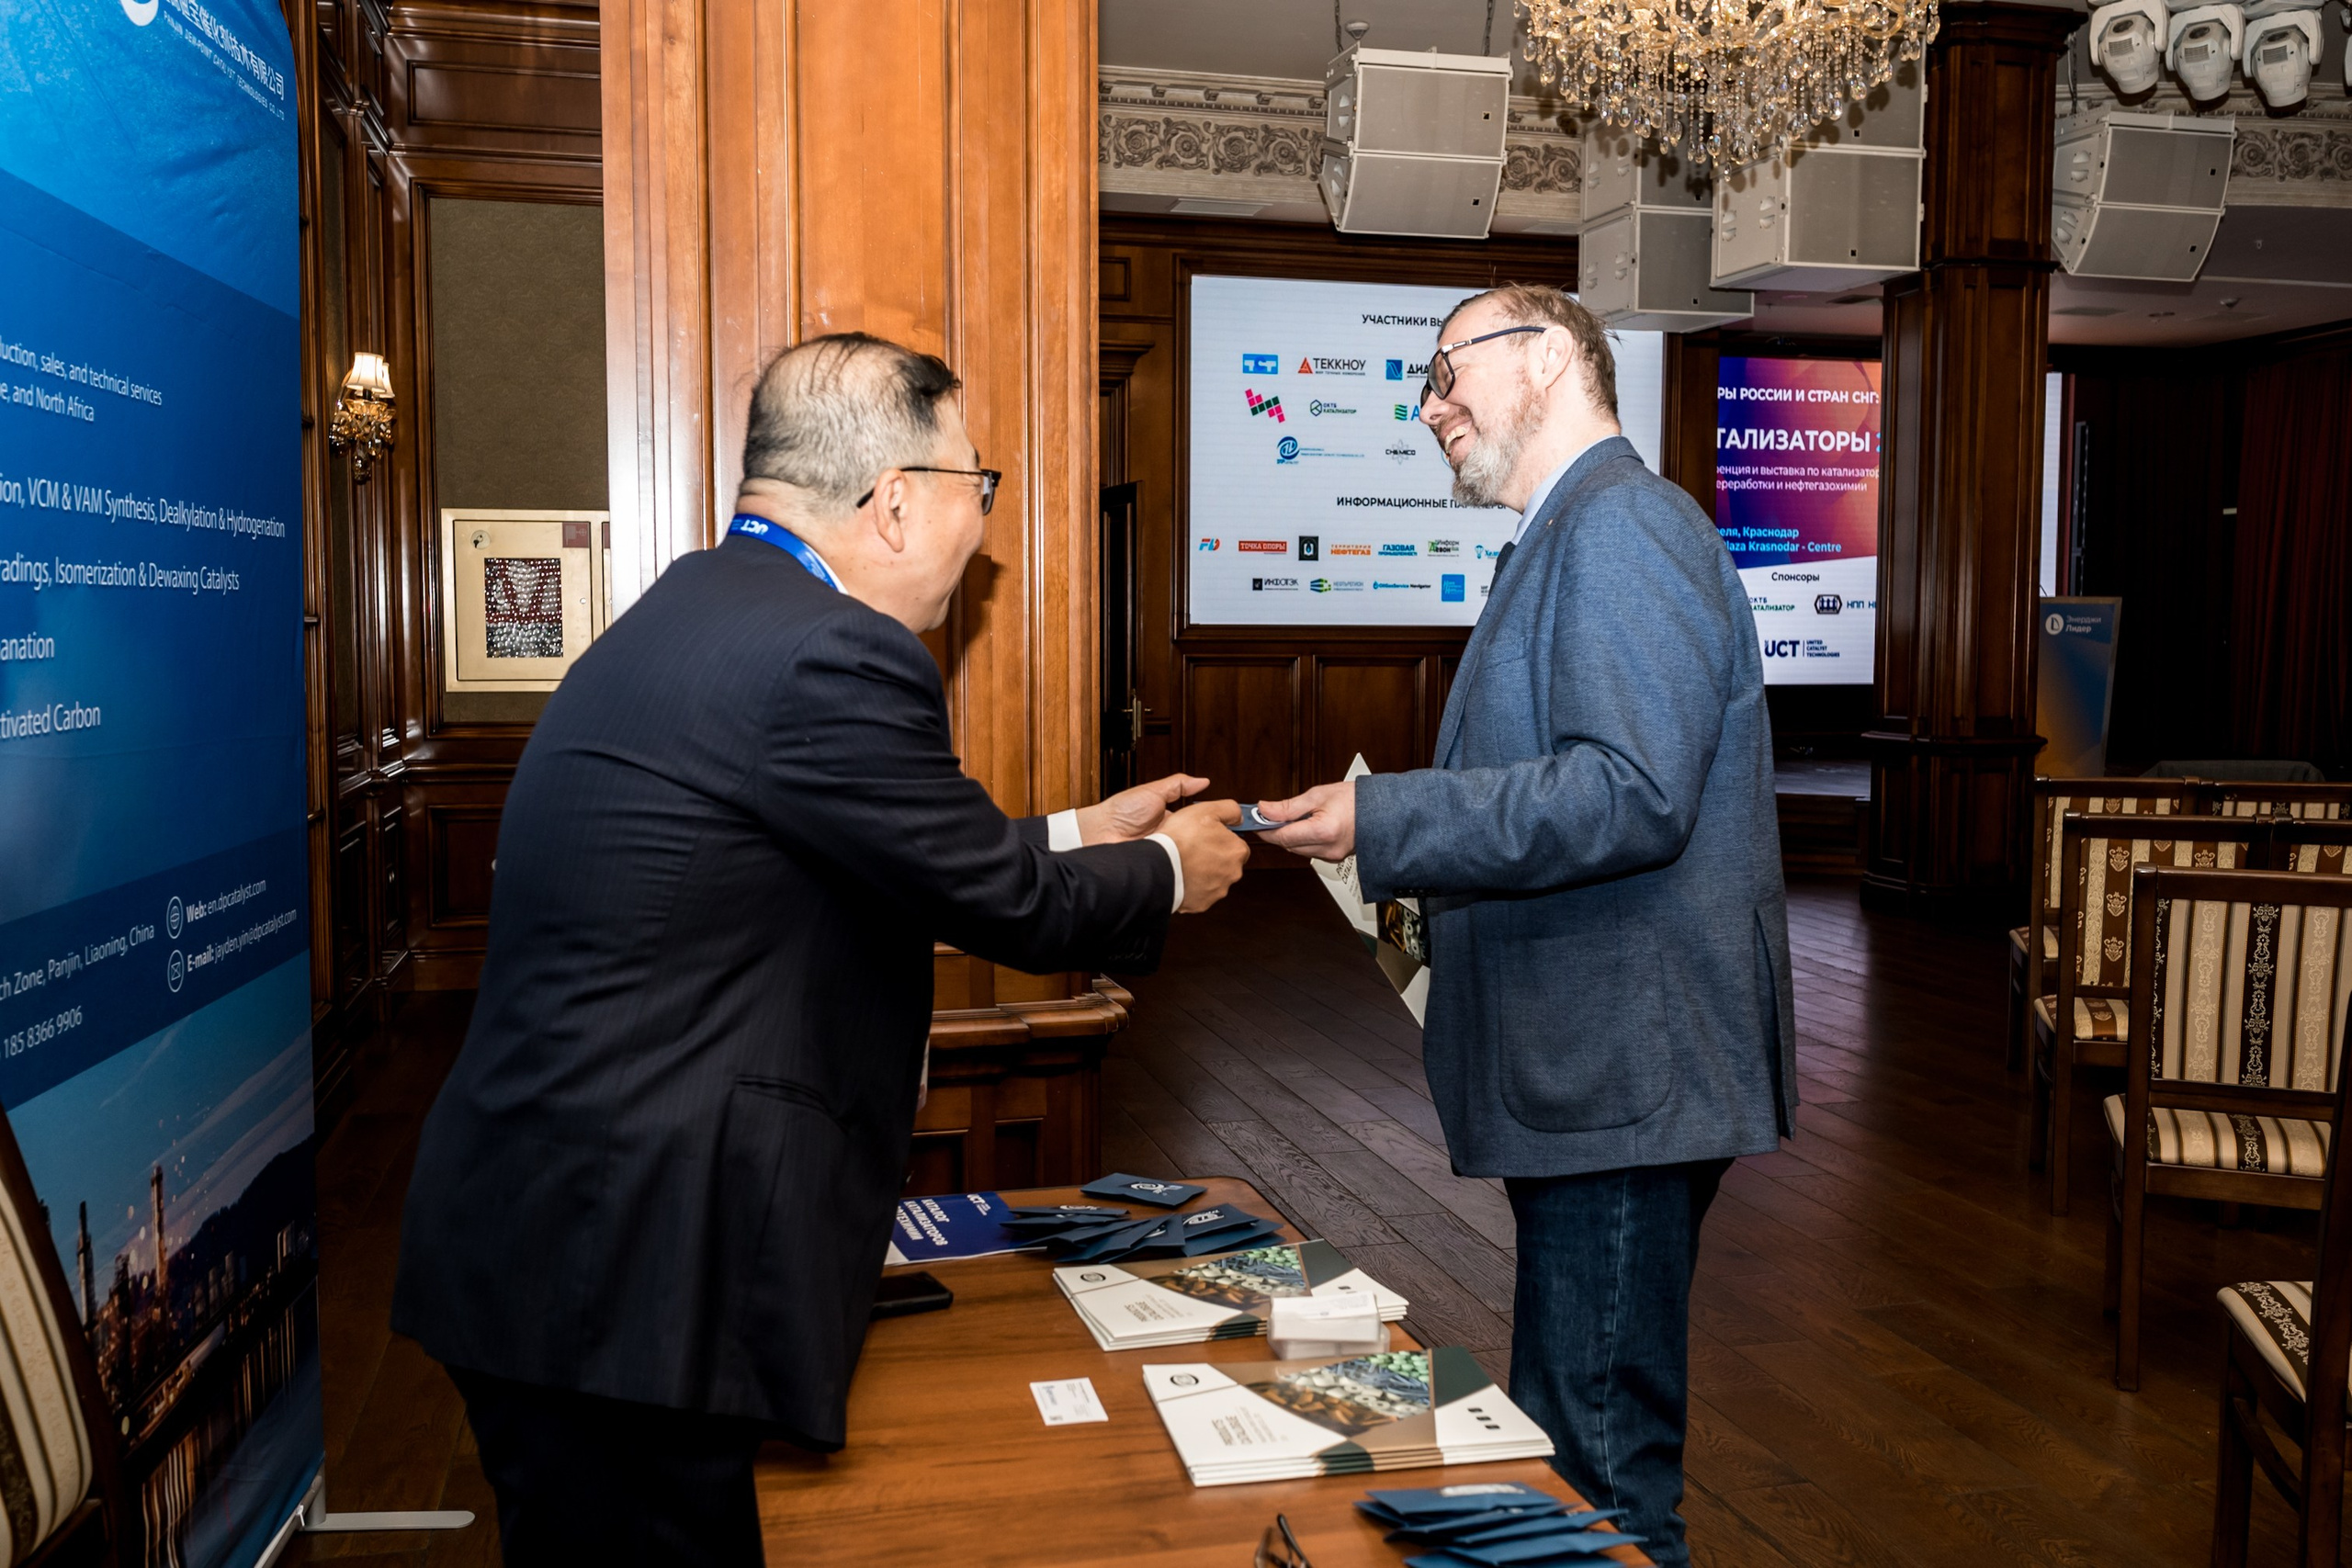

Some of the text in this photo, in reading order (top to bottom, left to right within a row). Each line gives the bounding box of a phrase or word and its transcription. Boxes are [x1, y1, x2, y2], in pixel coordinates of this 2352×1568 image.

[213, 54, 236, 80] CATALYST
[236, 75, 267, 107] TECHNOLOGIES
[1362, 314, 1427, 326] УЧАСТНИКИ
[0, 335, 162, 406] uction, sales, and technical services
[1313, 357, 1366, 370] ТЕККНОУ
[13, 384, 33, 407] and
[36, 387, 65, 414] North
[67, 396, 95, 422] Africa
[1740, 388, 1792, 401] РОССИИ
[1795, 389, 1804, 401] И
[1808, 389, 1849, 403] СТРАН
[1852, 391, 1879, 404] СНГ:
[1752, 467, 1758, 475] и
[1760, 466, 1805, 476] выставка
[1808, 467, 1819, 477] по
[1776, 480, 1783, 490] и
[1785, 479, 1867, 492] нефтегазохимии
[28, 477, 59, 508] VCM
[62, 482, 72, 511] &
[74, 484, 102, 514] VAM
[105, 490, 158, 525] Synthesis,
[160, 498, 217, 532] Dealkylation
[219, 508, 226, 531] &
[227, 509, 285, 540] Hydrogenation
[1337, 497, 1447, 509] ИНФОРМАЦИОННЫЕ
[1716, 526, 1799, 540] еля, Краснодар
[1724, 540, 1746, 552] laza
[1748, 541, 1799, 552] Krasnodar
[1808, 542, 1841, 552] Centre
[55, 556, 136, 586] Isomerization
[139, 562, 147, 587] &
[149, 562, 198, 596] Dewaxing
[200, 566, 240, 595] Catalysts
[1771, 572, 1819, 583] Спонсоры
[1847, 601, 1864, 609] НПП
[2064, 625, 2092, 633] Лидер
[2066, 615, 2102, 625] Энерджи
[1764, 639, 1800, 658] UCT
[53, 701, 101, 733] Carbon
[186, 879, 266, 923] Web: en.dpcatalyst.com
[14, 968, 46, 995] Zone,
[48, 952, 83, 980] Panjin,
[85, 936, 128, 965] Liaoning,
[130, 924, 154, 946] China
[187, 943, 214, 973] E-mail:
[4, 1005, 83, 1058] 185 8366 9906
[921, 1198, 950, 1223] КАТАЛОГ
[903, 1200, 948, 1247] КАТАЛИЗАТОРОВ
